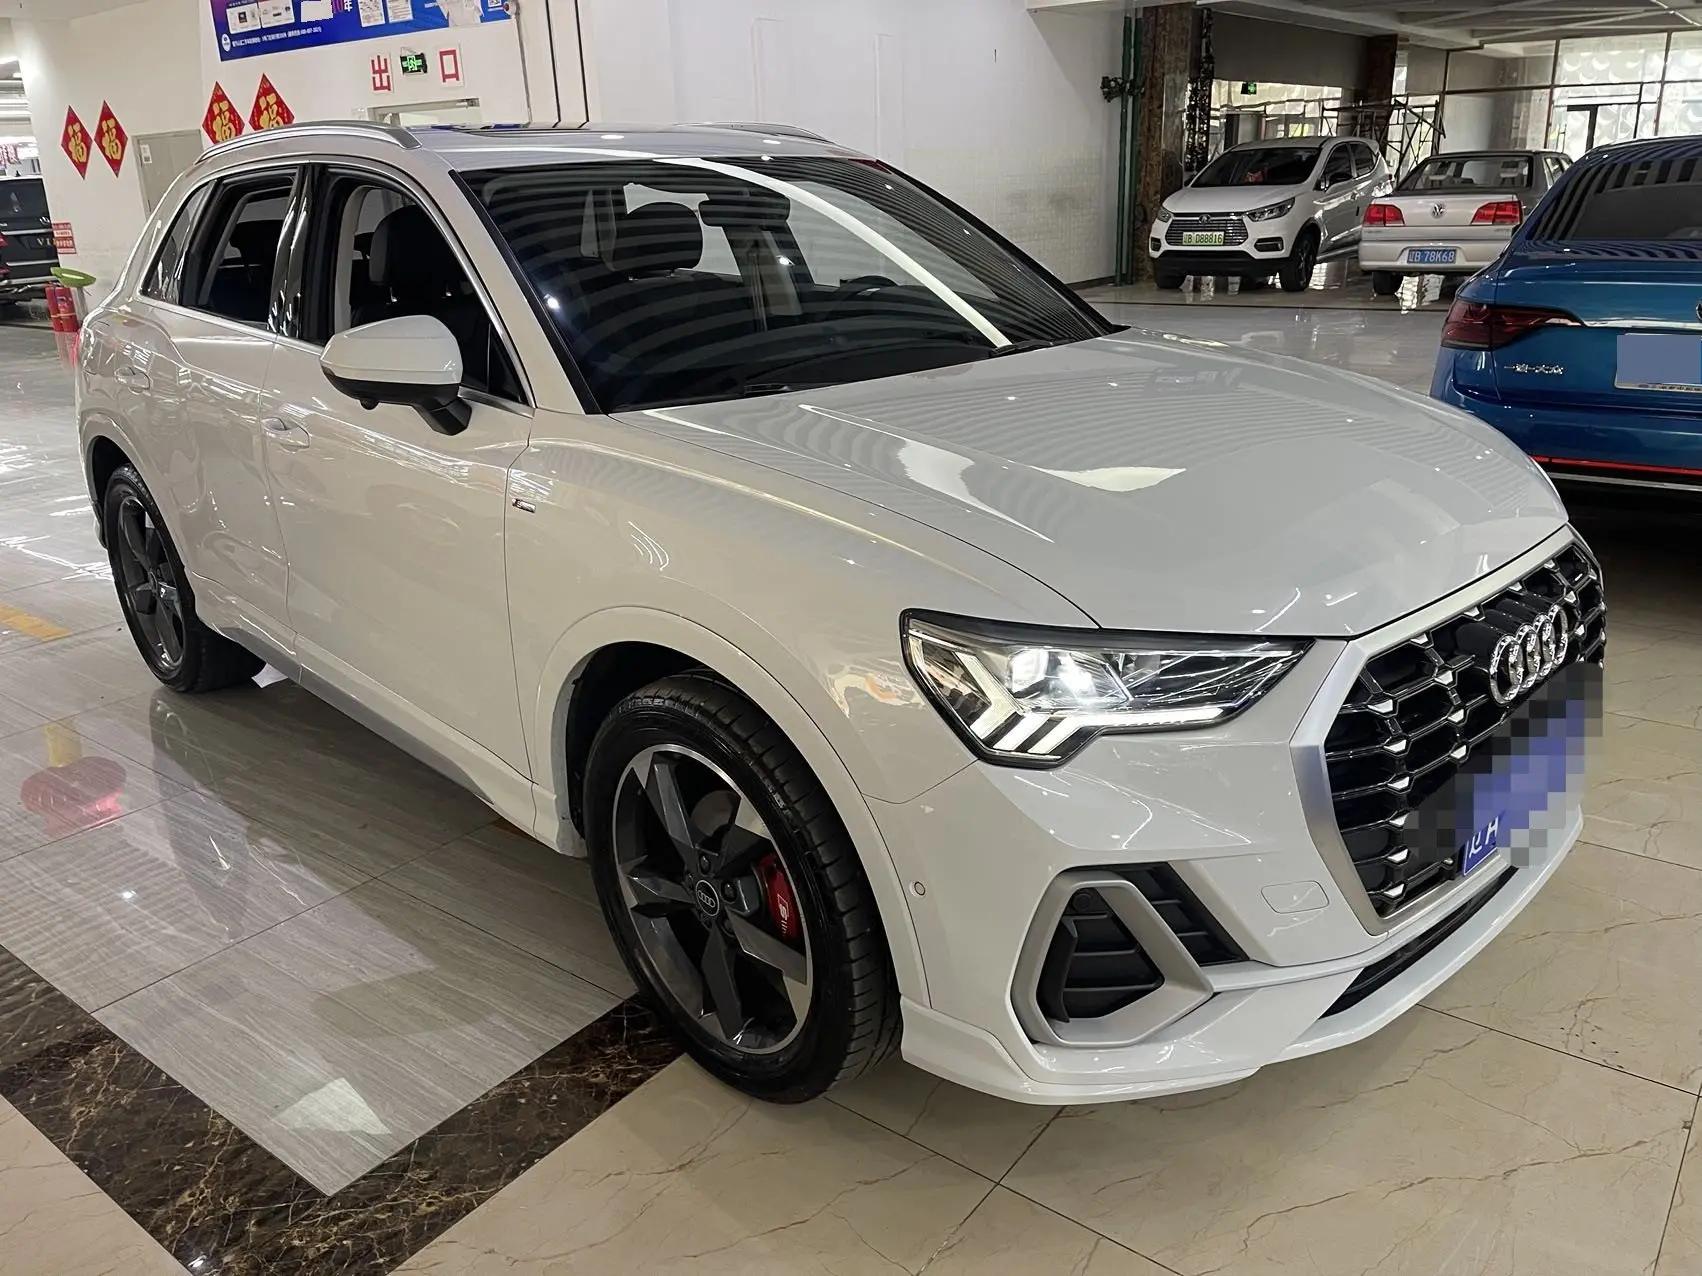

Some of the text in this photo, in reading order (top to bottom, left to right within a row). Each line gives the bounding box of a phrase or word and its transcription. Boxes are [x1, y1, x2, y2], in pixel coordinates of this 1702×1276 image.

[371, 49, 460, 91] 出 口
[102, 118, 122, 160] 福
[212, 100, 236, 142] 福
[68, 122, 87, 163] 福
